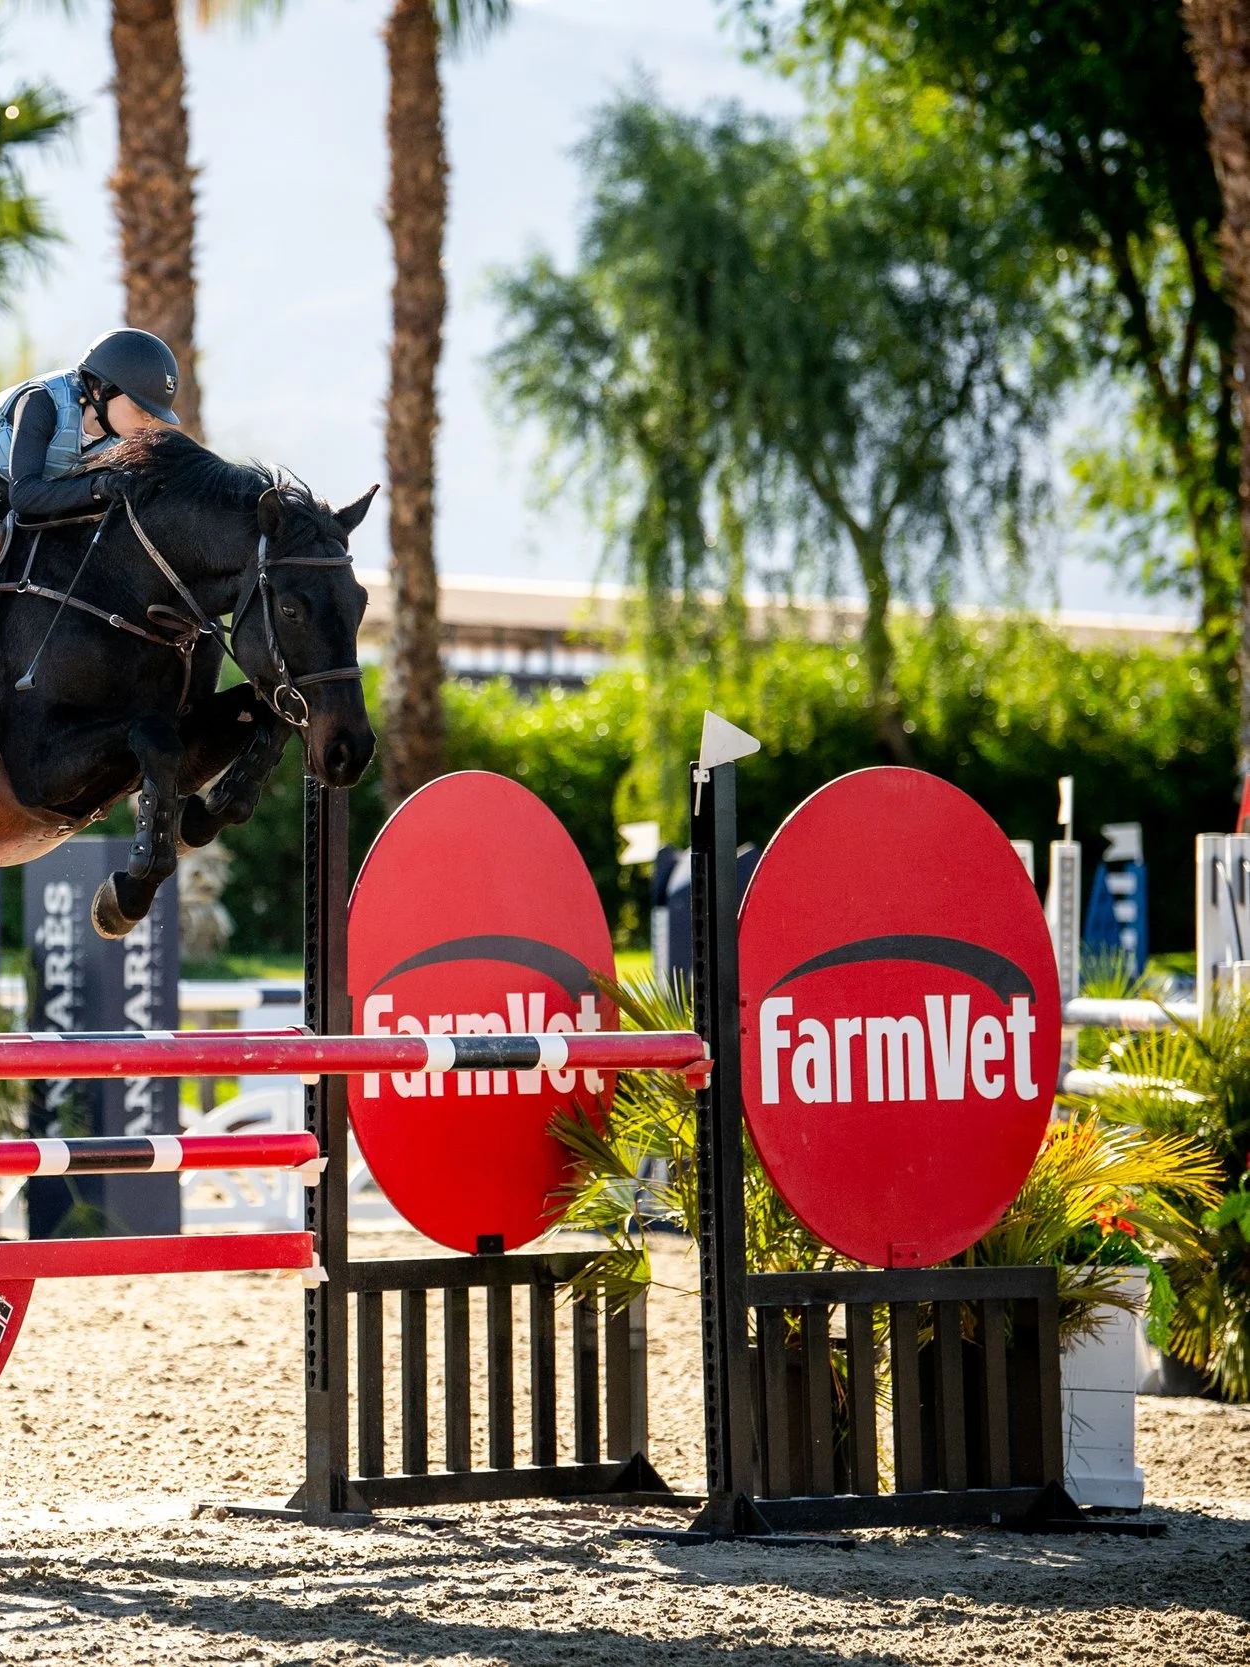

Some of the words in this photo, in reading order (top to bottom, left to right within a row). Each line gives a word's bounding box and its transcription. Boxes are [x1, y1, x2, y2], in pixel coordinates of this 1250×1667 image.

[33, 881, 74, 1137] NARÈS
[363, 992, 605, 1099] FarmVet
[759, 994, 1039, 1105] FarmVet
